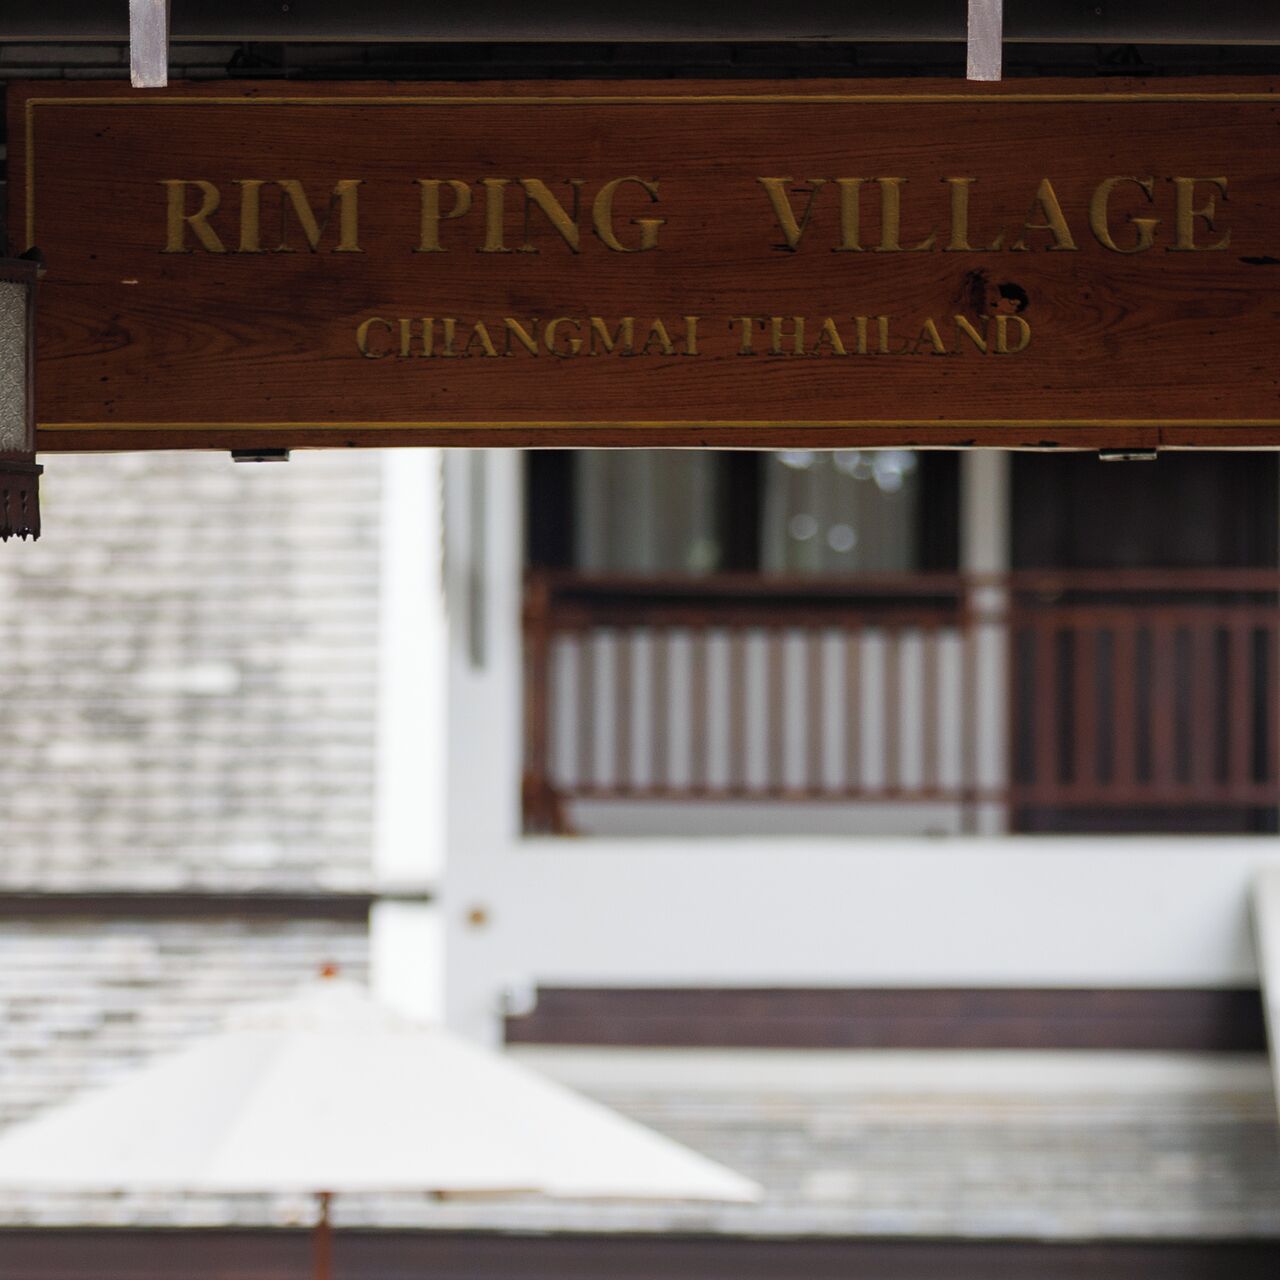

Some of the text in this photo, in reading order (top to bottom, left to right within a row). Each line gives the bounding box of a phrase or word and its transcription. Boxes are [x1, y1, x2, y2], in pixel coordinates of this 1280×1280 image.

[158, 174, 1233, 255] RIM PING VILLAGE
[356, 314, 1032, 359] CHIANGMAI THAILAND
